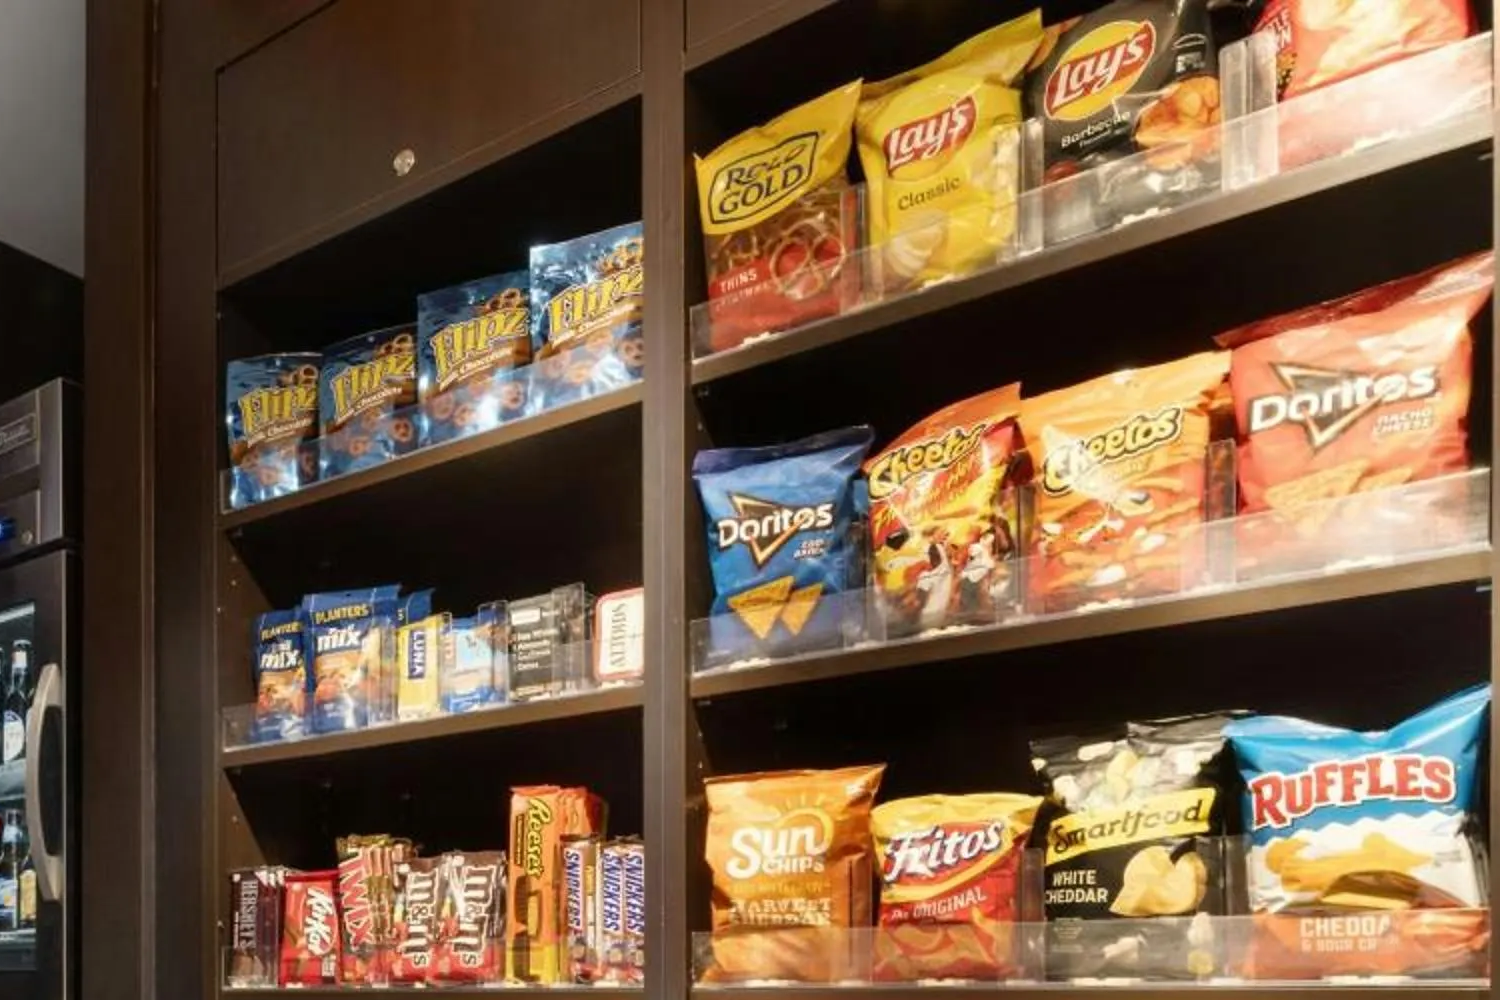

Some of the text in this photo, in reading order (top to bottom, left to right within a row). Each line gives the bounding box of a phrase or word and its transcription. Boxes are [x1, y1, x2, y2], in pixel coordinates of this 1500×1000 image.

[1052, 31, 1150, 109] Lay's
[888, 99, 971, 167] Lay's
[718, 162, 804, 215] GOLD
[897, 174, 962, 211] Classic
[1249, 364, 1438, 433] Doritos
[717, 502, 834, 549] Doritos
[259, 649, 299, 669] mix
[410, 631, 426, 678] LUNA
[1250, 756, 1457, 830] RUFFLES
[527, 798, 552, 878] Reese's
[726, 825, 830, 879] Sun
[886, 819, 1005, 883] Fritos
[1052, 799, 1204, 853] Smartfood
[339, 847, 374, 952] TWIX
[602, 852, 622, 932] SNICKERS
[913, 885, 988, 918] ORIGINAL
[1052, 869, 1097, 887] WHITE
[1300, 914, 1392, 938] CHEDDA
